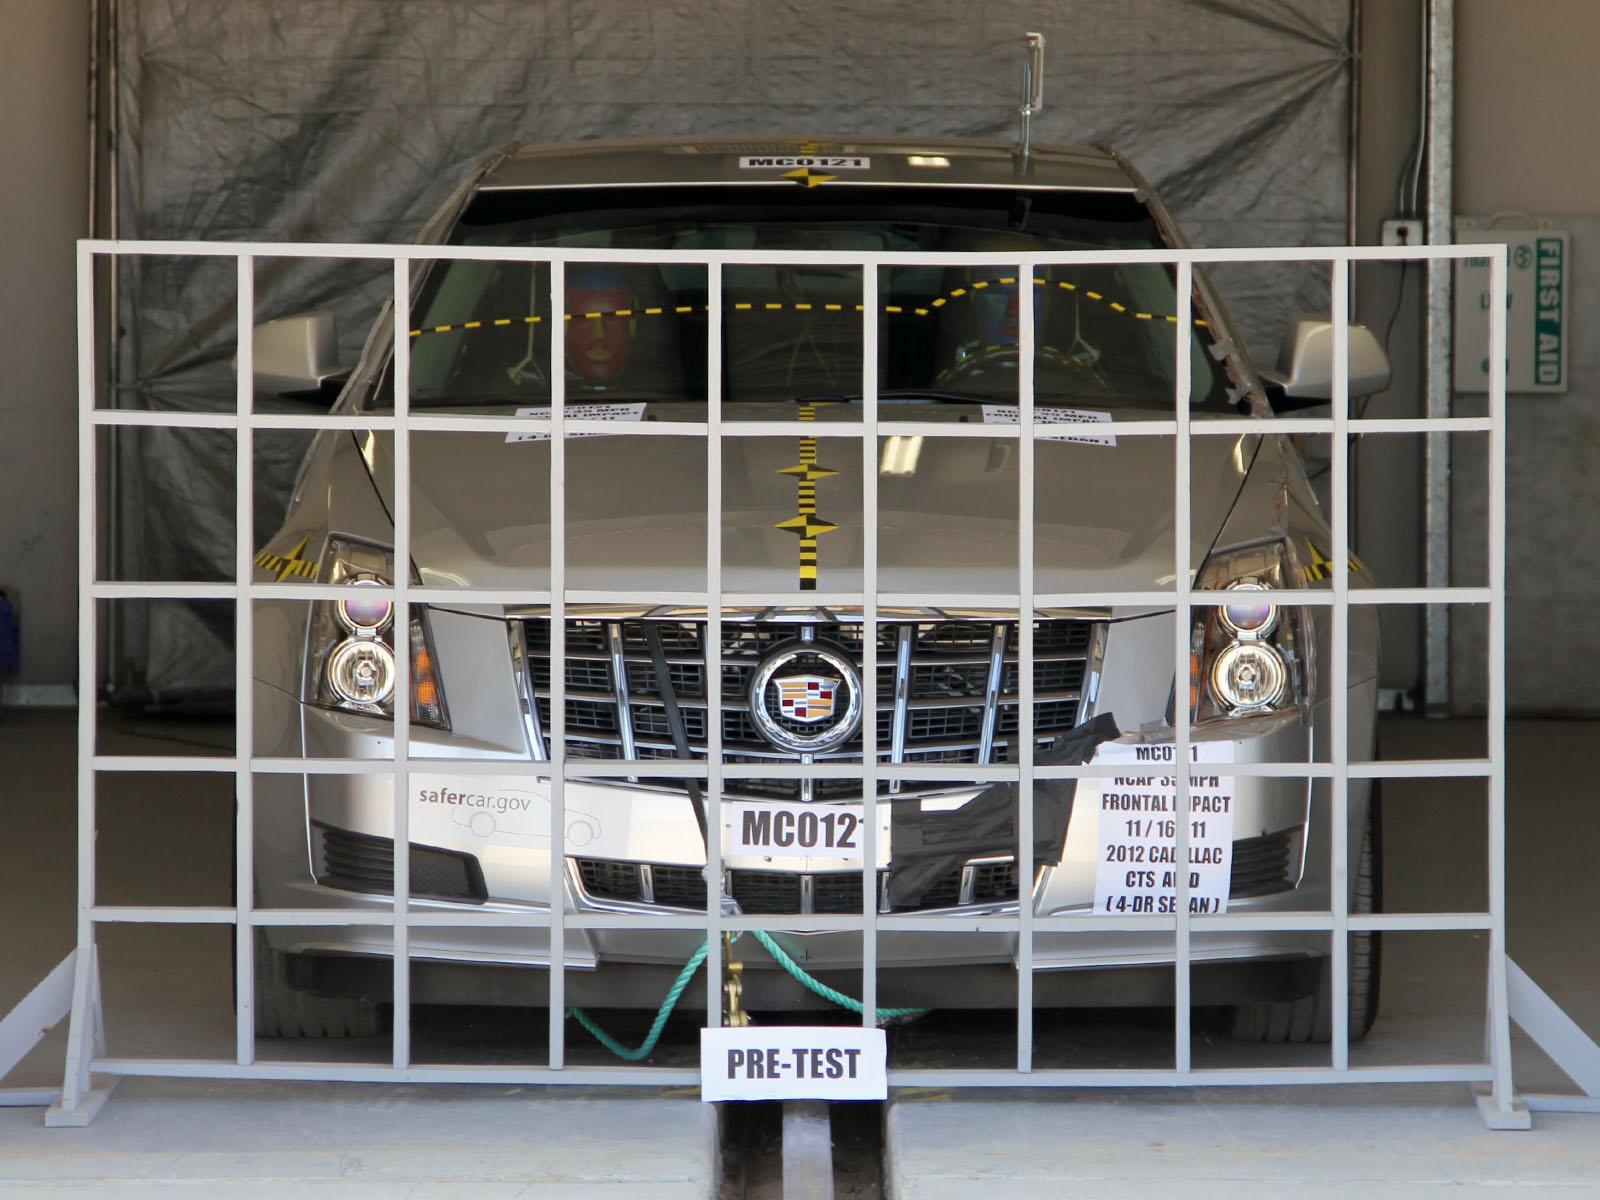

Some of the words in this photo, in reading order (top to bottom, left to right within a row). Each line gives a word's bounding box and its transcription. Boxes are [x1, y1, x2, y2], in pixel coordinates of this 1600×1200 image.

[748, 158, 863, 167] MC0121
[1540, 240, 1561, 322] FIRST
[1539, 332, 1560, 383] AID
[1136, 745, 1199, 762] MC01
[418, 787, 532, 814] safercar.gov
[1102, 793, 1168, 812] FRONTAL
[1172, 795, 1231, 813] IPACT
[742, 810, 864, 849] MC012
[1106, 845, 1145, 863] 2012
[1149, 846, 1223, 864] CADLLAC
[1125, 871, 1155, 888] CTS
[1162, 871, 1200, 889] AD
[1158, 896, 1210, 914] SEAN
[727, 1048, 861, 1080] PRE-TEST
